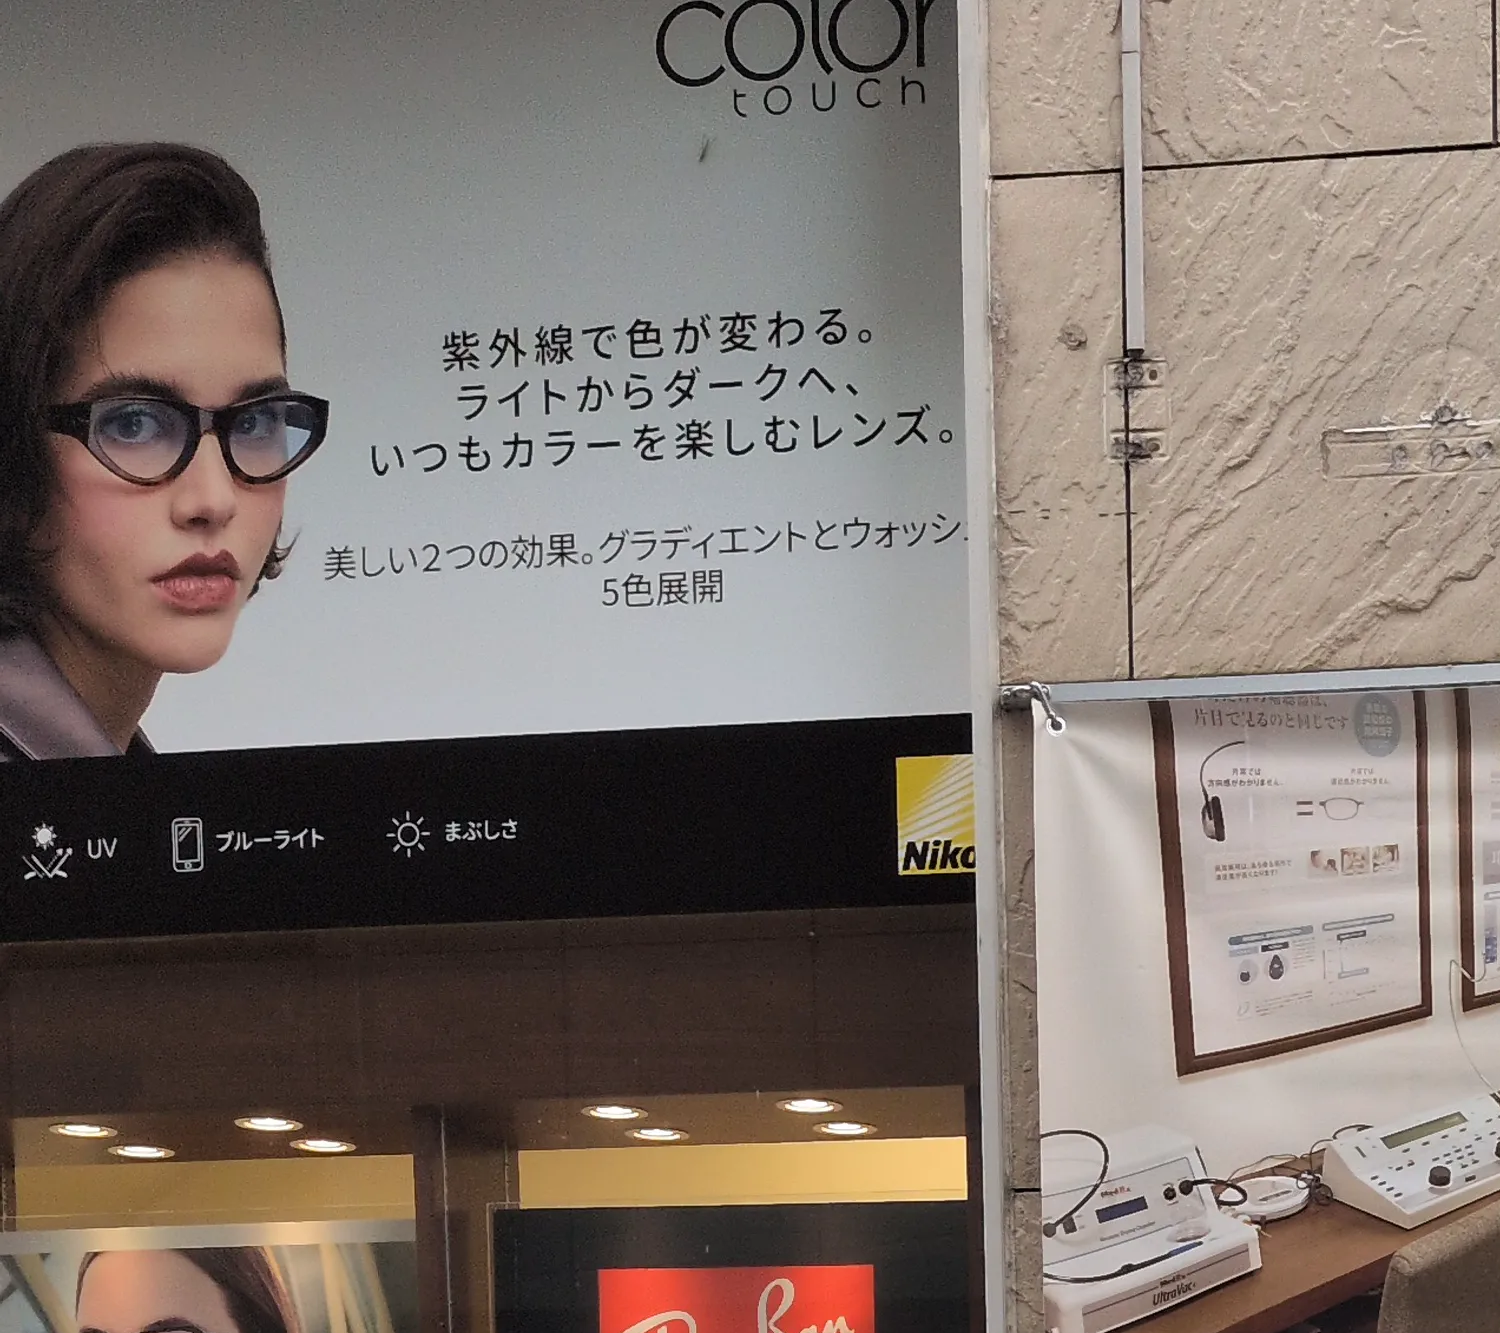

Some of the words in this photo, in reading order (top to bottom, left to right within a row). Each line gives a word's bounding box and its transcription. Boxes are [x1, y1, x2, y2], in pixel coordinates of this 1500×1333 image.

[656, 0, 938, 87] color
[733, 75, 926, 118] touch
[441, 307, 873, 371] 紫外線で色が変わる。
[456, 362, 861, 422] ライトからダークへ、
[371, 403, 955, 477] いつもカラーを楽しむレンズ。
[324, 513, 969, 581] 美しい2つの効果。グラディエントとウォッシ
[602, 569, 724, 608] 5色展開
[87, 837, 118, 859] UV
[215, 827, 326, 852] ブルーライト
[444, 818, 519, 842] まぶしさ
[902, 839, 976, 871] Niko
